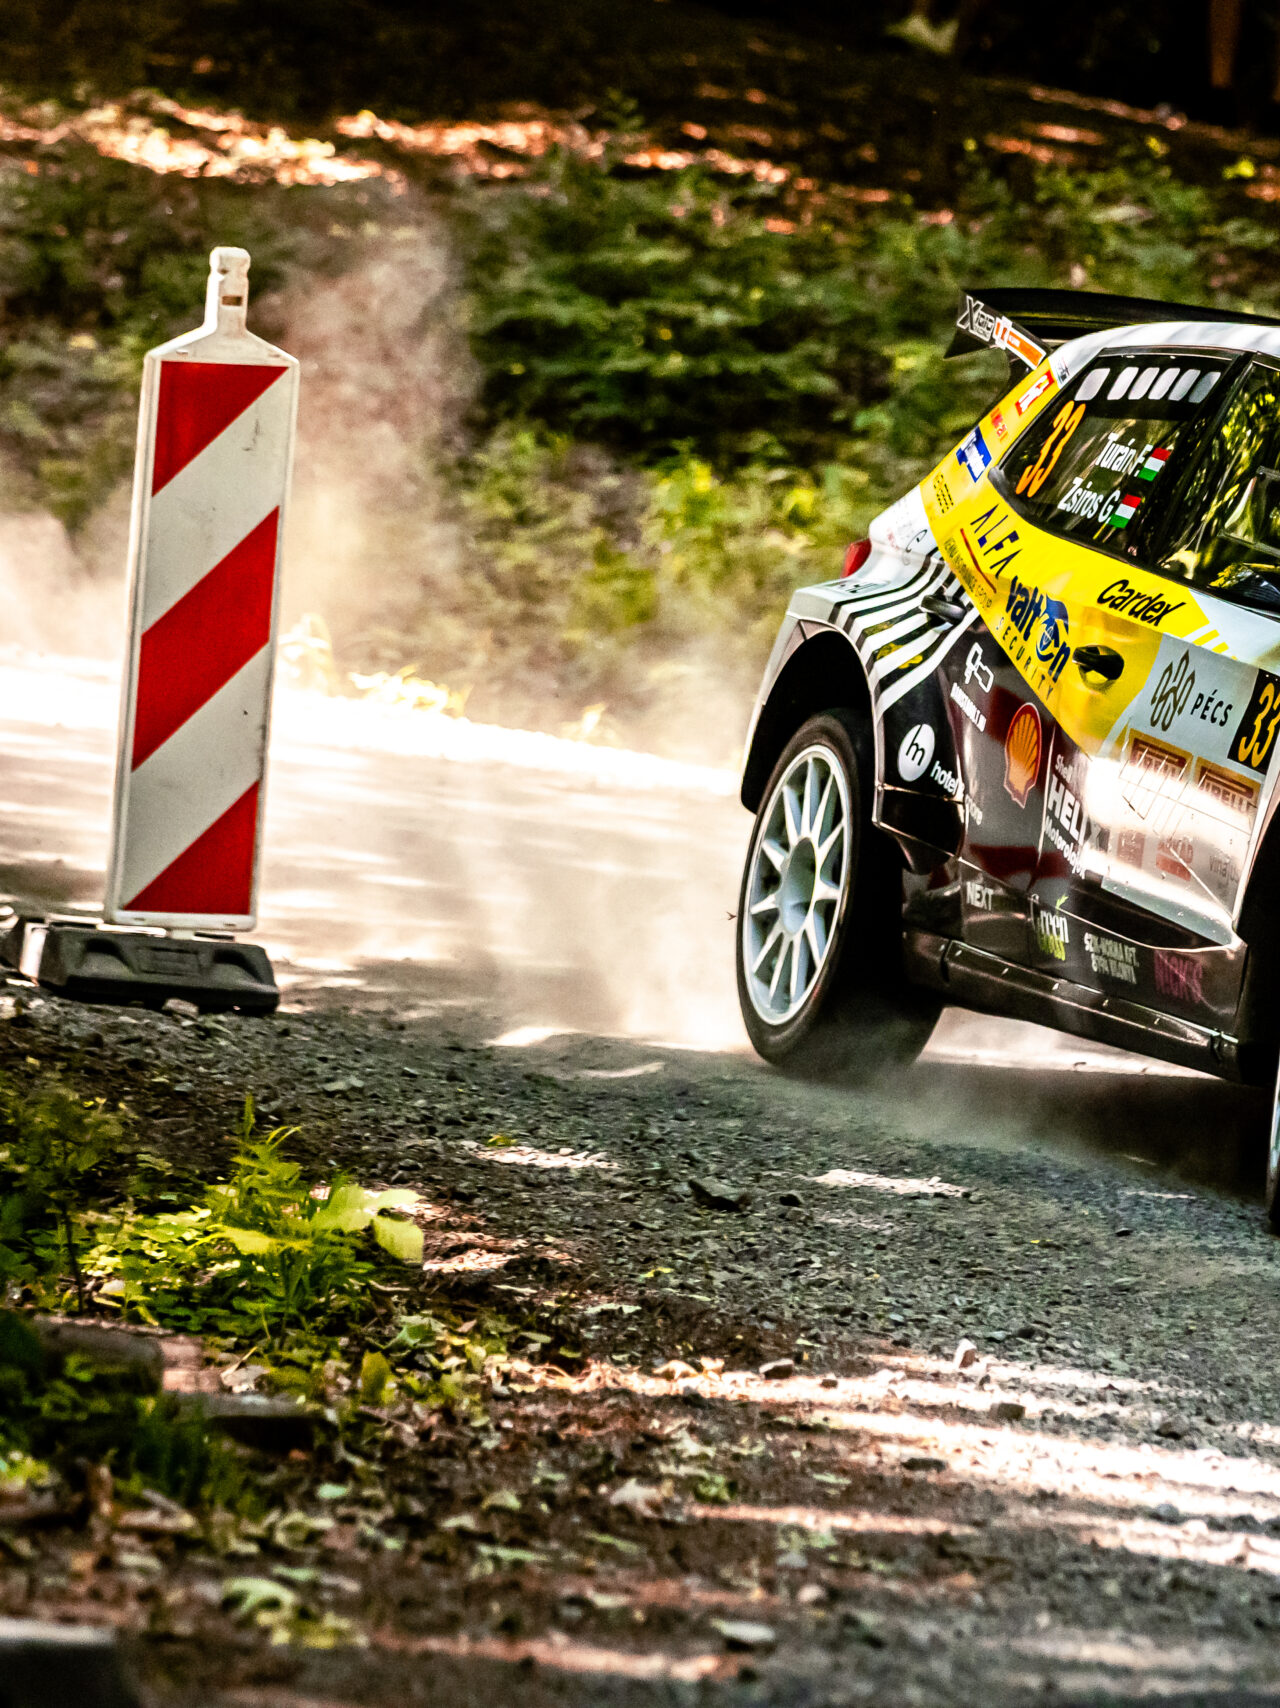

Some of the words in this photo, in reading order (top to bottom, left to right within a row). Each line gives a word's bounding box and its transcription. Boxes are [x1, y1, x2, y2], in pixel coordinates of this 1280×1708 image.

[1016, 400, 1087, 498] 33
[1095, 432, 1137, 473] Turán
[1057, 477, 1105, 519] Zsiros
[970, 504, 1024, 579] ALFA
[1097, 579, 1187, 627] Cardex
[996, 616, 1054, 700] SECURITY
[1190, 690, 1233, 727] PÉCS
[966, 881, 994, 911] NEXT
